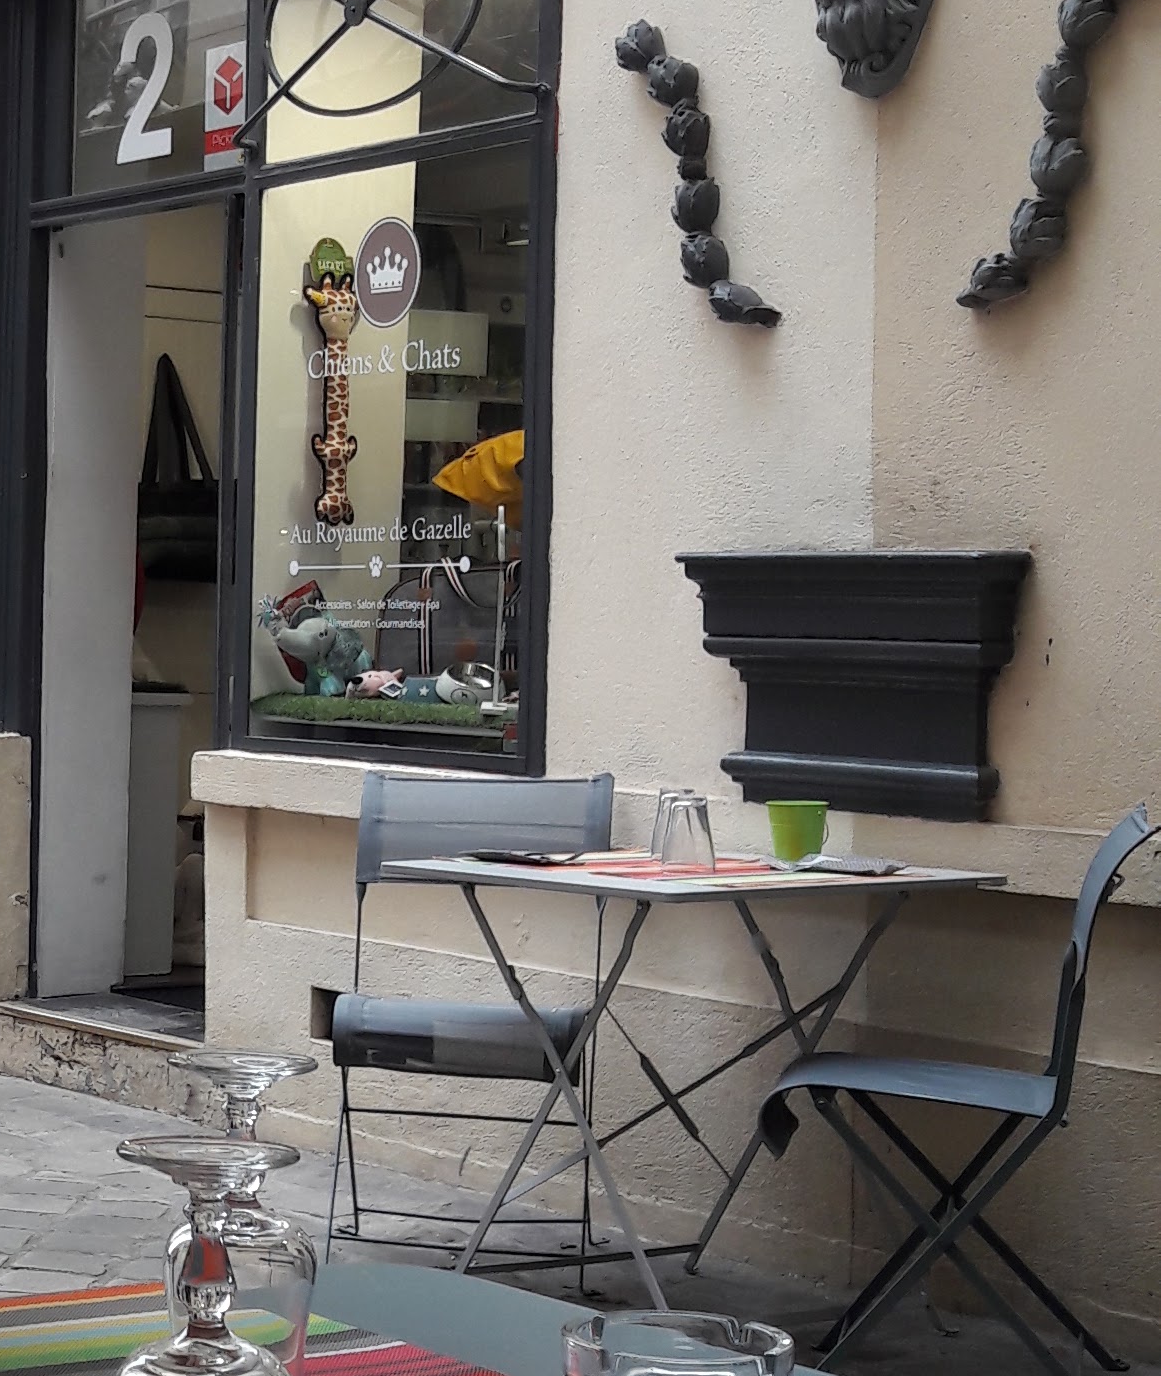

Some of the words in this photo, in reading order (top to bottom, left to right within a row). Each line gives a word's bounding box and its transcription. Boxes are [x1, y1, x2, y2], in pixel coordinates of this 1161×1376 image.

[116, 12, 174, 165] 2
[308, 347, 373, 379] Chiens
[377, 344, 396, 373] &
[401, 339, 461, 372] Chats
[290, 525, 312, 544] Au
[315, 522, 386, 551] Royaume
[389, 517, 408, 541] de
[412, 514, 471, 541] Gazelle
[314, 598, 353, 610] Accessoires
[356, 598, 376, 610] Salon
[377, 598, 386, 610] de
[327, 616, 371, 629] Alimentation
